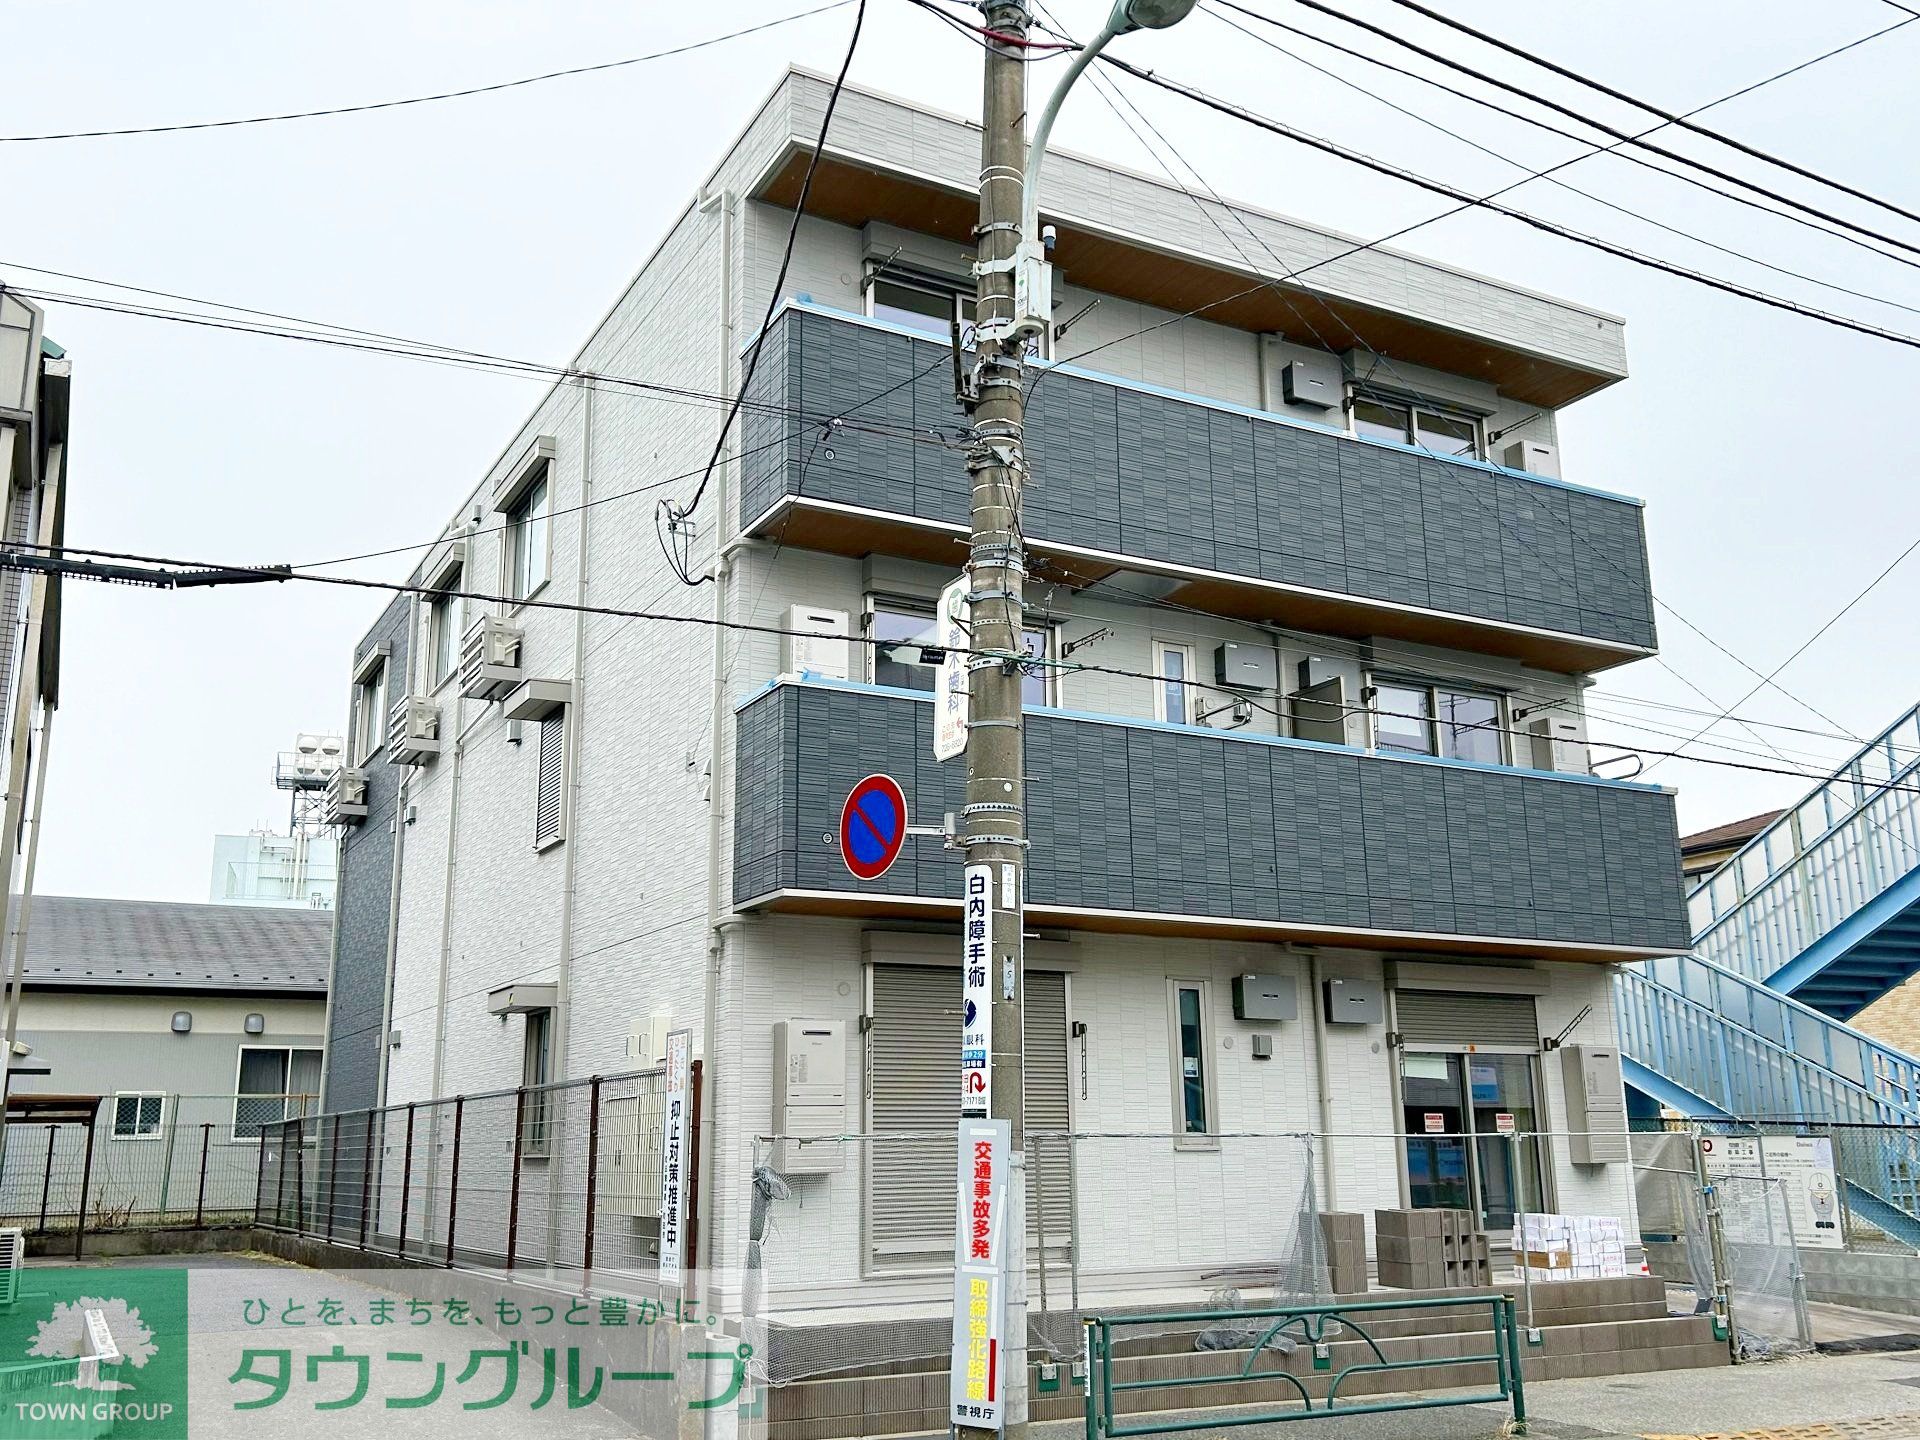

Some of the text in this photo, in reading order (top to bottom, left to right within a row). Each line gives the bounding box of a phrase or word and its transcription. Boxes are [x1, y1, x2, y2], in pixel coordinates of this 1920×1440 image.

[968, 873, 986, 988] 白内障手術
[963, 1033, 985, 1046] 眼科
[666, 1099, 681, 1248] 抑止対策推進中
[971, 1140, 993, 1260] 交通事故多発
[965, 1278, 988, 1402] 取締強化路線
[956, 1403, 995, 1420] 警視庁
